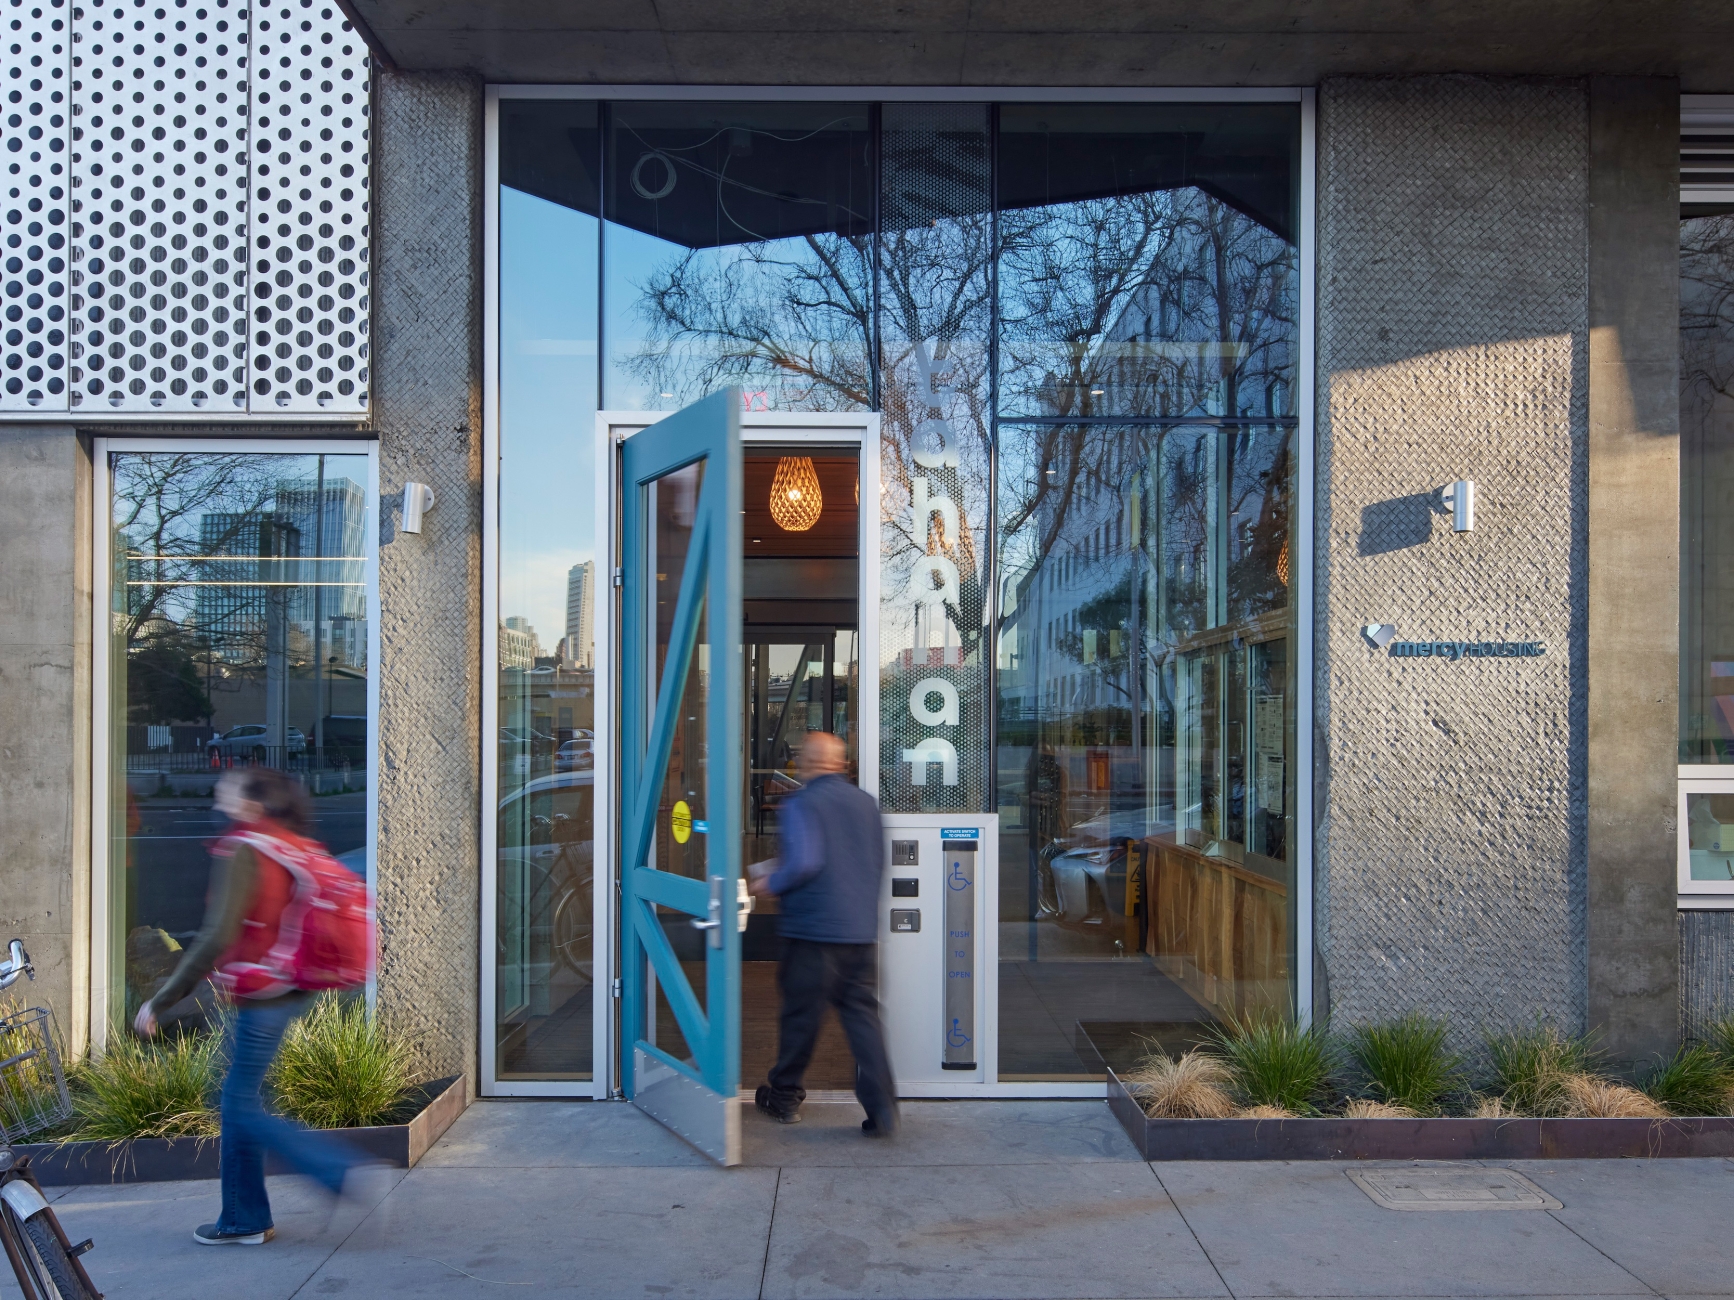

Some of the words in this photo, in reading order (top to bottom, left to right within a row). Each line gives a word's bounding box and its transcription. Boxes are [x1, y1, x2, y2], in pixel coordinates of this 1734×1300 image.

[1396, 640, 1467, 660] mercy
[1469, 640, 1547, 657] HOUSING
[950, 930, 970, 938] PUSH
[954, 950, 965, 958] TO
[948, 970, 971, 978] OPEN
